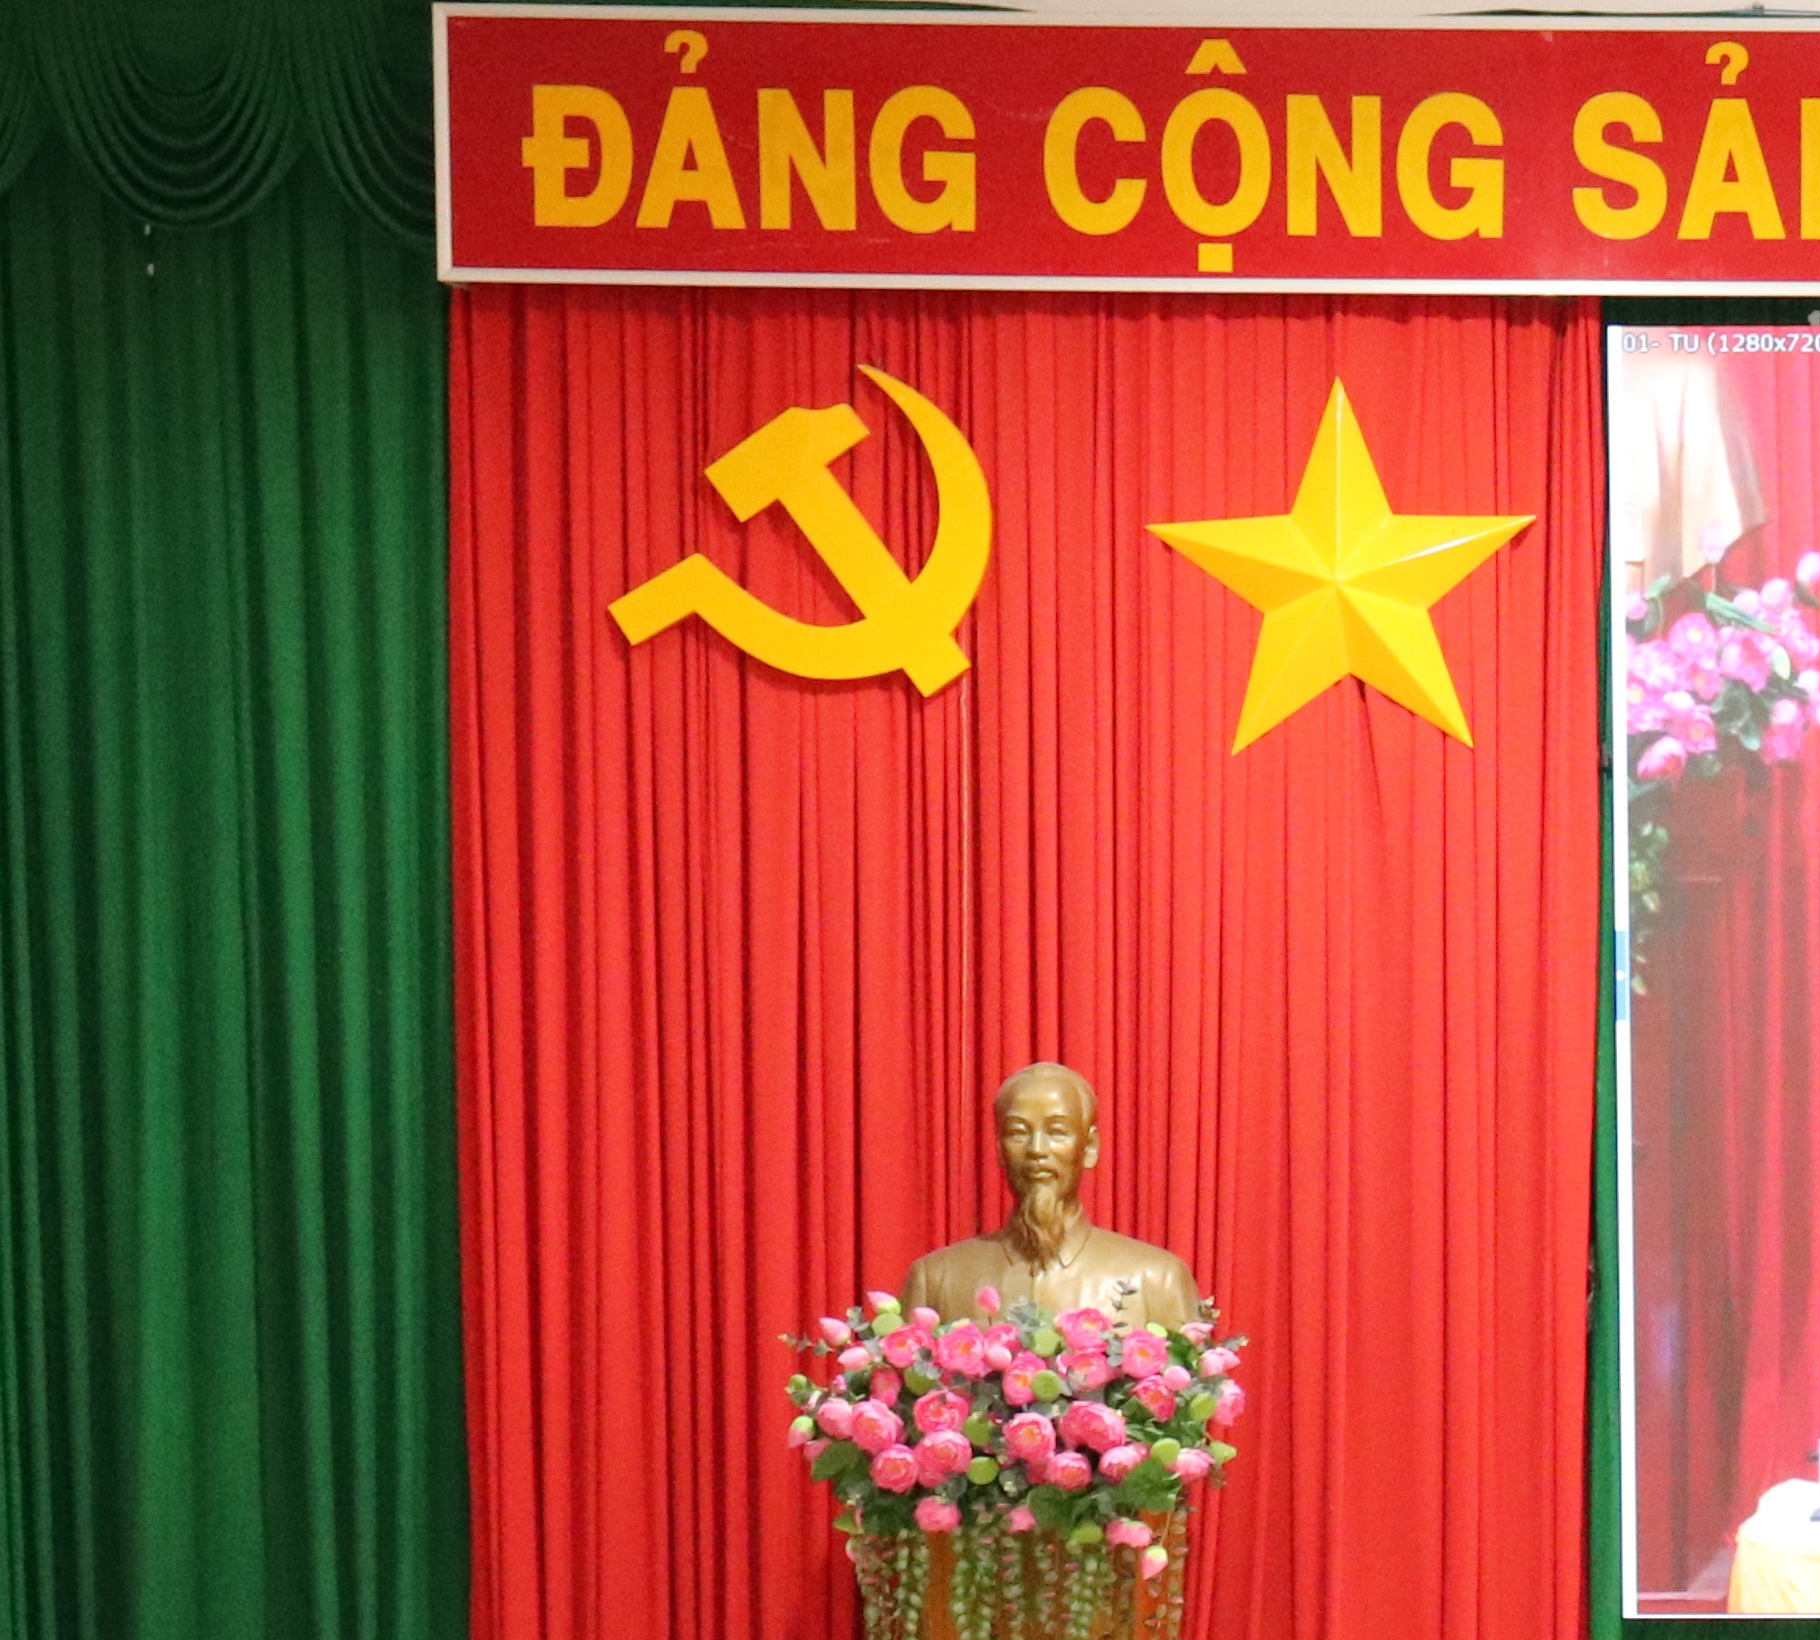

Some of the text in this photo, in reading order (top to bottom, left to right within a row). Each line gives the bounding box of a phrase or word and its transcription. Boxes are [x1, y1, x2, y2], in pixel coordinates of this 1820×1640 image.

[522, 30, 977, 233] ĐẢNG
[1043, 38, 1506, 273] CỘNG
[1669, 333, 1699, 352] TU
